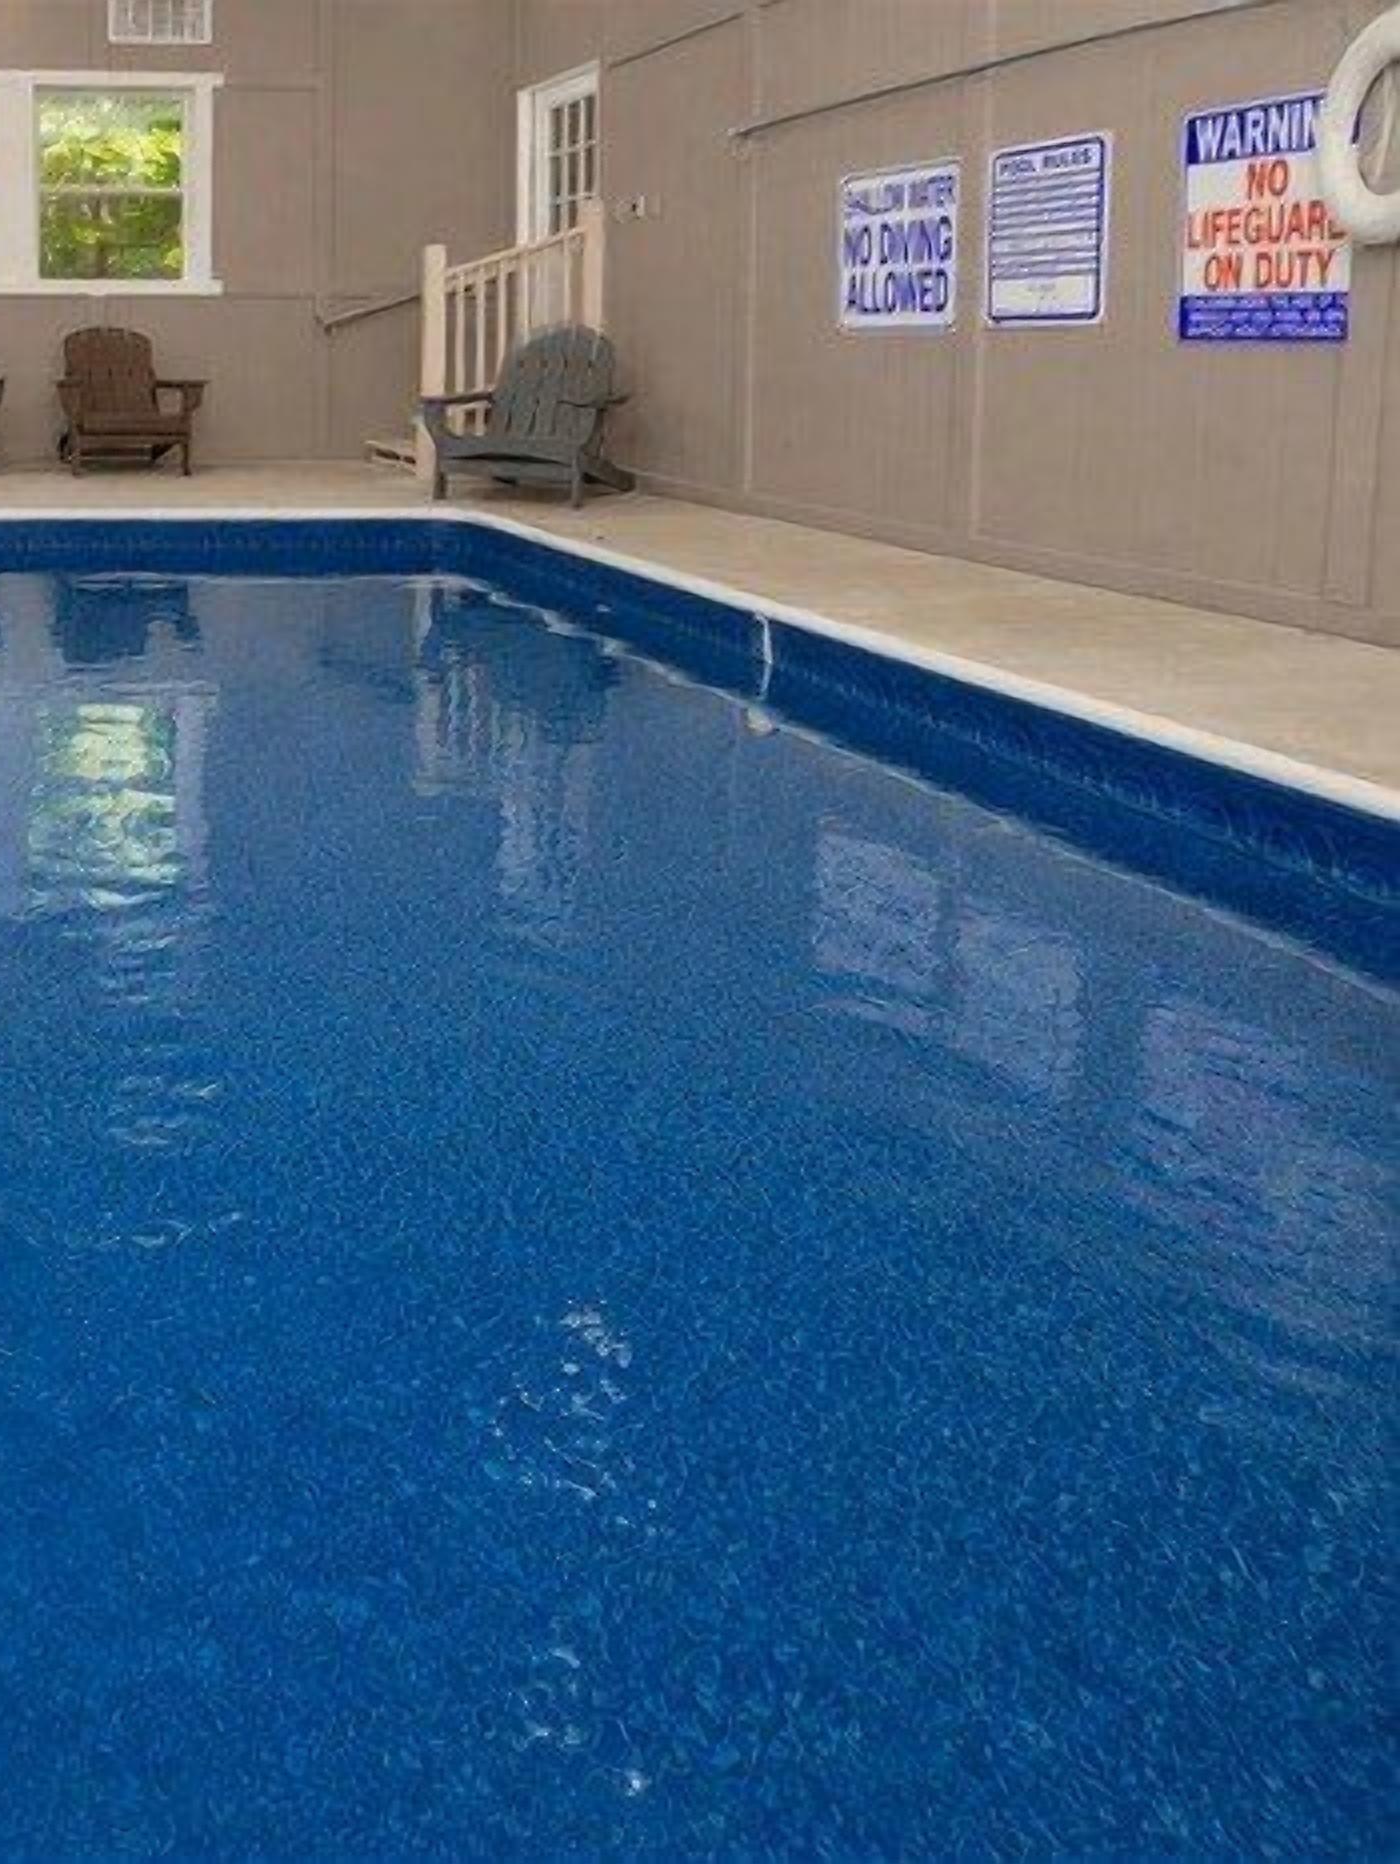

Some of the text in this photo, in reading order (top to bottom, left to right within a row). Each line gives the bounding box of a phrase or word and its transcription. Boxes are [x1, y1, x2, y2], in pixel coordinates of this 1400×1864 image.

[1246, 160, 1289, 200] NO
[845, 225, 872, 268] NO
[879, 216, 953, 267] DIVING
[845, 268, 949, 315] ALLOWED
[1204, 249, 1337, 292] ON DUTY
